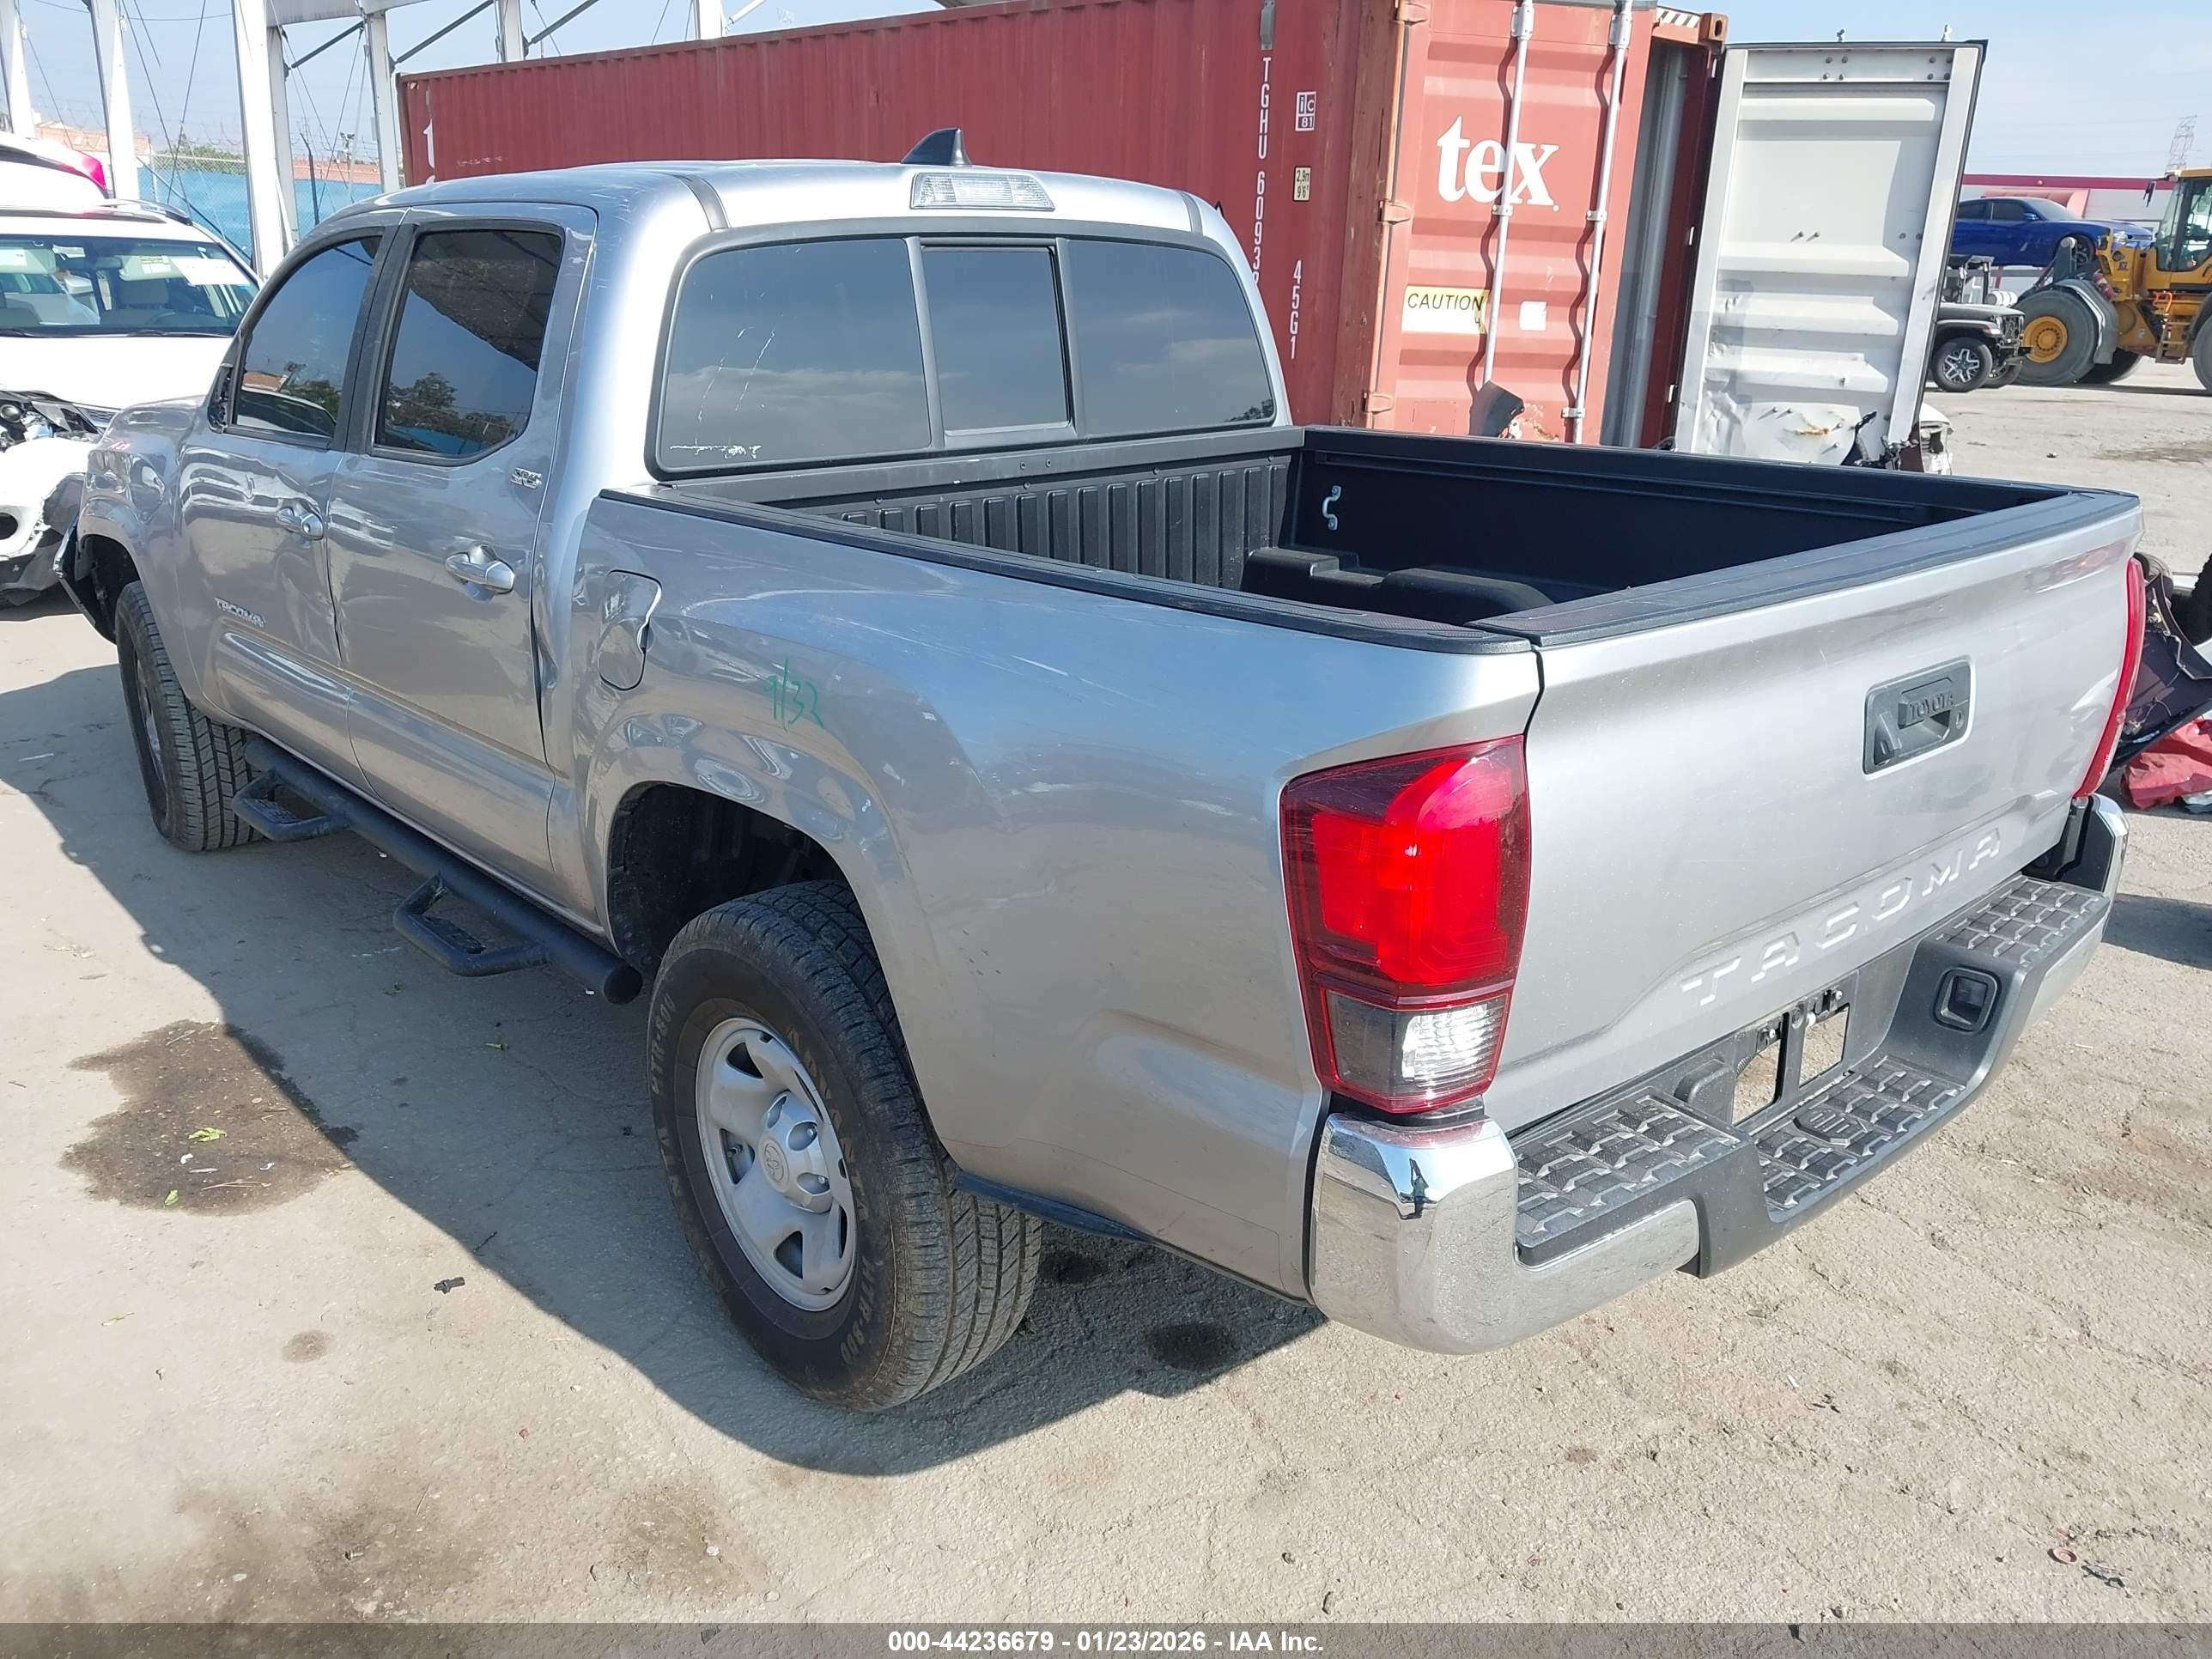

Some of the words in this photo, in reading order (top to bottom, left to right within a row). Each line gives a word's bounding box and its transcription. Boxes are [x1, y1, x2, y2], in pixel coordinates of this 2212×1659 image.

[1257, 57, 1272, 159] TGHU
[1301, 116, 1314, 129] 81
[1289, 259, 1303, 360] 45G1
[1407, 292, 1485, 311] CAUTION
[1909, 691, 1954, 720] TOYOTA
[1680, 827, 2001, 1006] TACOMA
